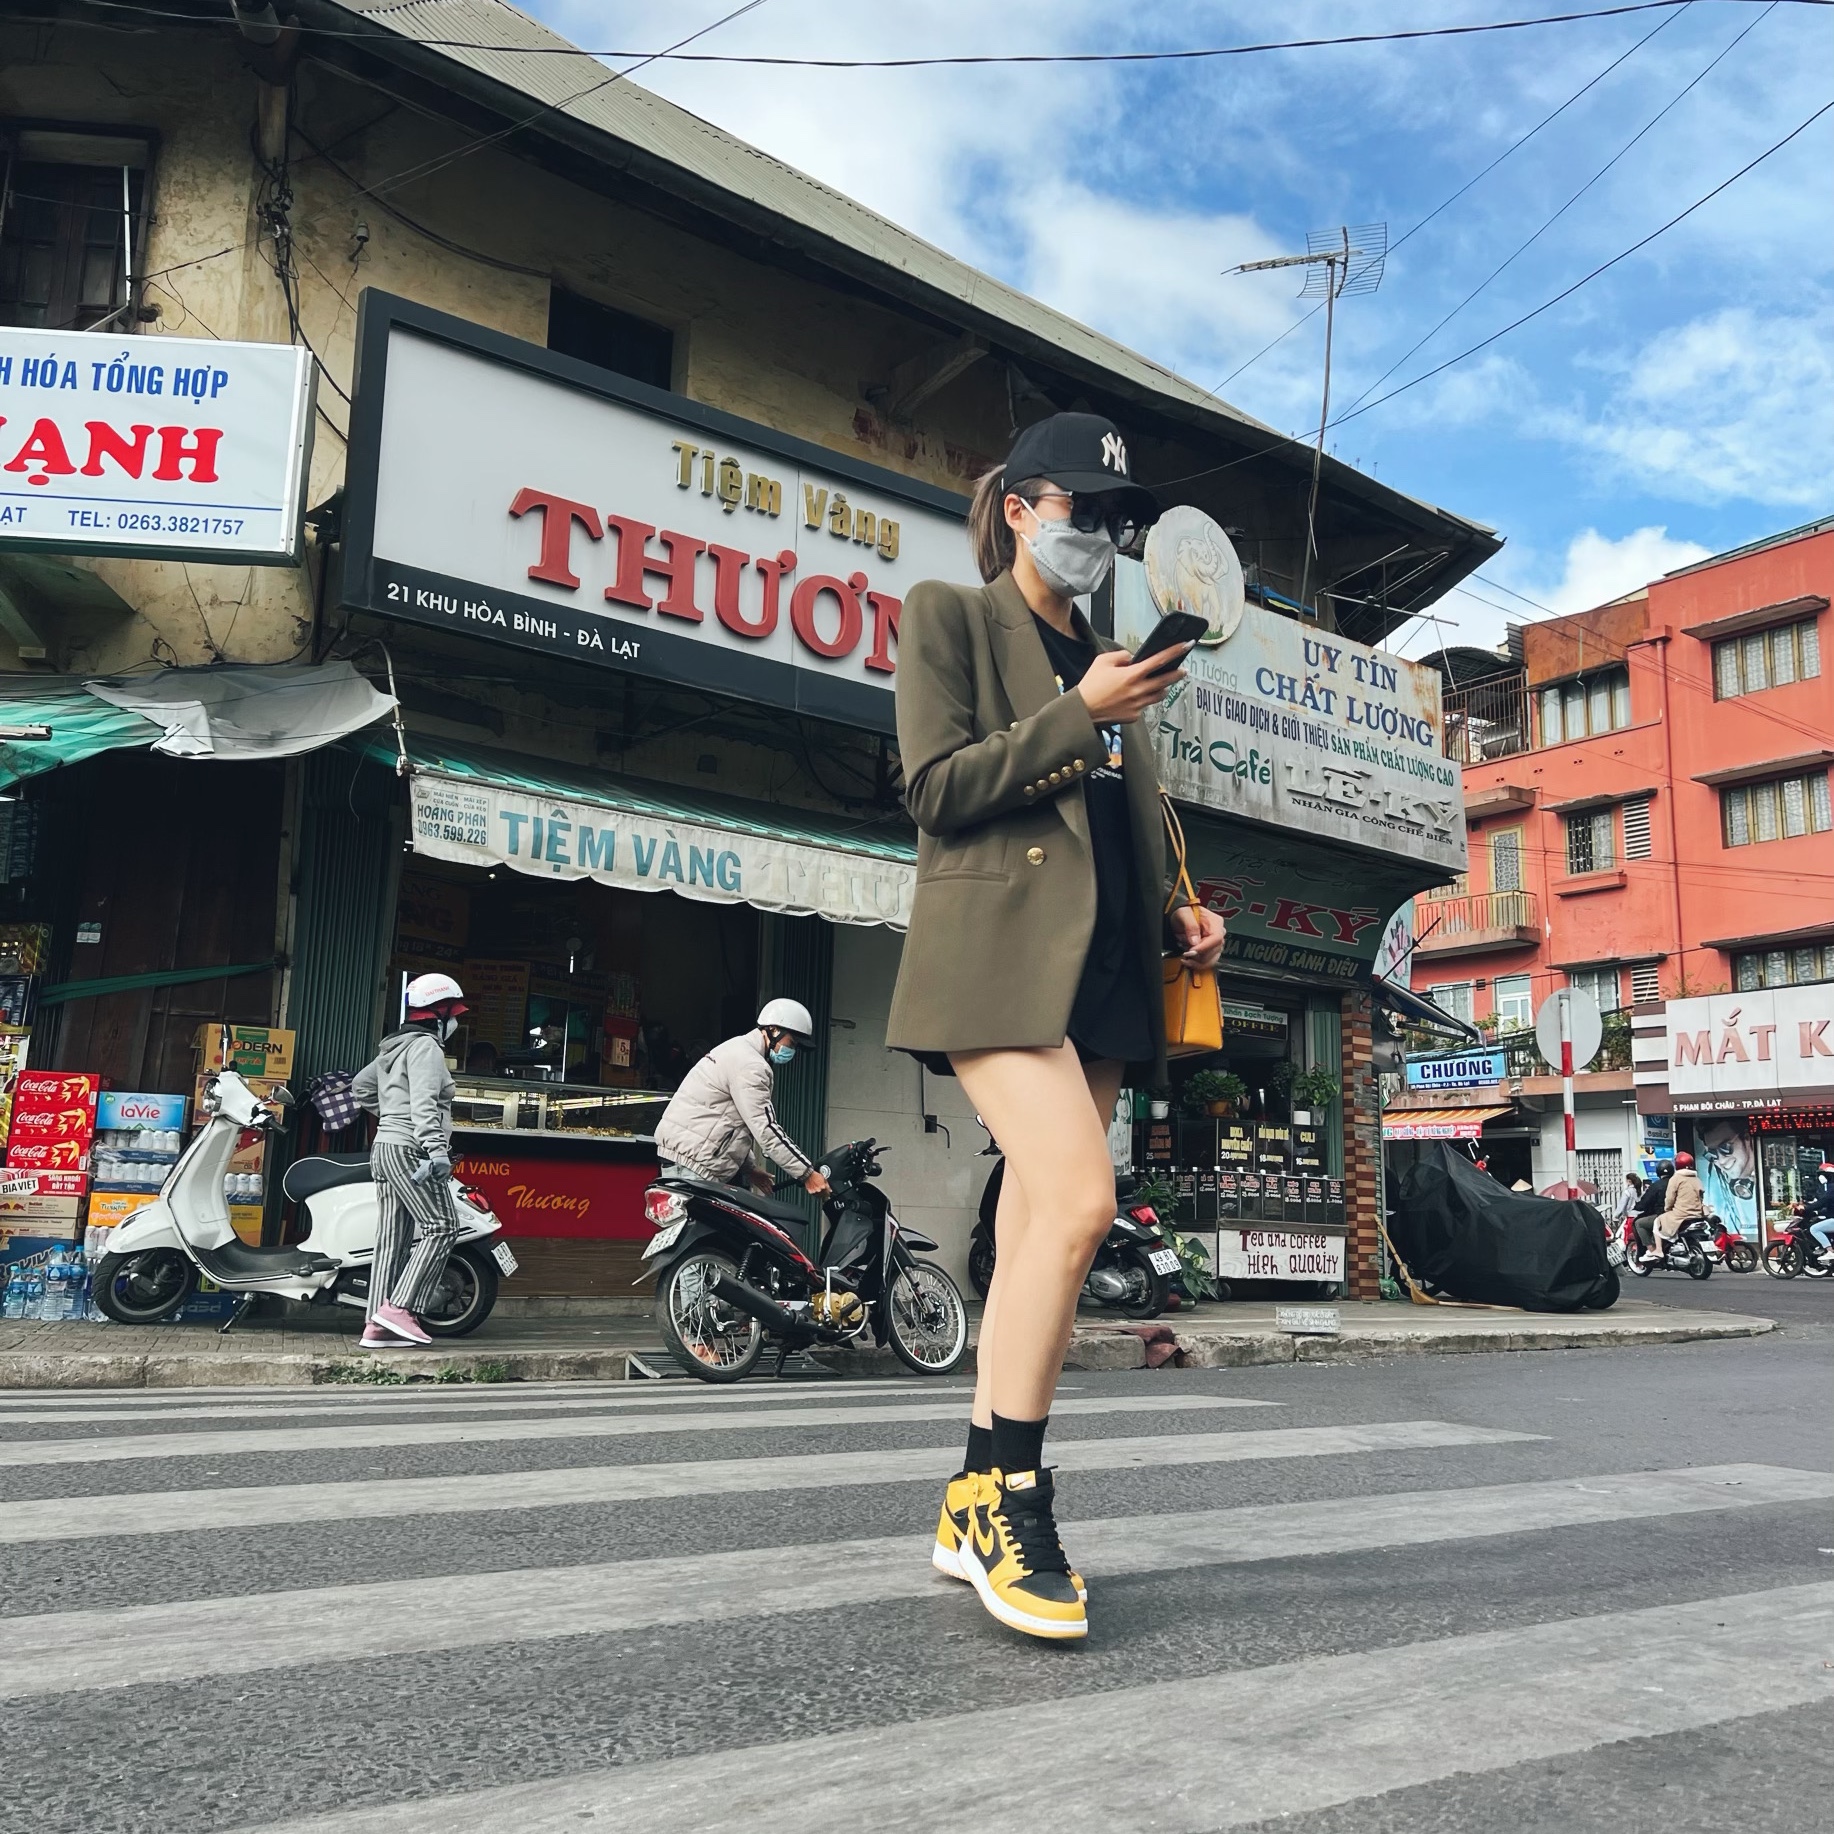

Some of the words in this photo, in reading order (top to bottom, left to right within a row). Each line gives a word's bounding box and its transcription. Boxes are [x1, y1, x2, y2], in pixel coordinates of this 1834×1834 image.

[21, 353, 77, 390] HÓA
[92, 351, 164, 395] TỔNG
[173, 365, 229, 405] HỢP
[0, 415, 224, 486] ẠNH
[68, 510, 111, 529] TEL:
[117, 513, 244, 535] 0263.3821757
[671, 440, 782, 518] Tiệm
[802, 482, 901, 561] Vàng
[387, 582, 409, 603] 21
[416, 589, 457, 615] KHU
[463, 600, 507, 627] HÒA
[513, 611, 557, 639] BÌNH
[577, 628, 604, 650] ĐÀ
[611, 637, 641, 660] LẠT
[1302, 637, 1342, 674] UY
[1350, 654, 1398, 693] TÍN
[1256, 667, 1338, 716] CHẤT
[1346, 695, 1434, 748] LƯỢNG
[1160, 720, 1203, 765] Trà
[1209, 740, 1271, 785] Café
[1196, 686, 1211, 716] ĐẠI
[1213, 690, 1223, 717] LÝ
[1225, 697, 1247, 725] GIAO
[1249, 705, 1270, 734] DỊCH
[1272, 713, 1279, 736] &
[1282, 714, 1301, 742] GIỚI
[1302, 721, 1329, 752] THIỆU
[1331, 728, 1351, 757] SẢN
[1352, 737, 1380, 766] PHẨM
[1381, 746, 1406, 772] CHẤT
[1407, 755, 1435, 782] LƯỢNG
[1436, 766, 1454, 787] CAO
[417, 803, 454, 823] HOÀNG
[1292, 797, 1332, 814] NHẬN
[1335, 808, 1359, 820] GIA
[1362, 815, 1396, 830] CÔNG
[1398, 824, 1424, 837] CHẾ
[1426, 832, 1454, 846] BIẾN
[500, 809, 615, 873] TIỆM
[632, 829, 742, 893] VÀNG
[1227, 1018, 1280, 1033] OFFEE
[1674, 1007, 1777, 1067] MẮT
[1420, 1059, 1493, 1079] CHƯƠNG
[1679, 1103, 1700, 1111] PHAN
[1701, 1101, 1713, 1111] BỘI
[1715, 1100, 1735, 1110] CHÂU
[2, 1183, 18, 1194] BIA
[1239, 1230, 1265, 1252] Tea
[1267, 1233, 1287, 1248] and
